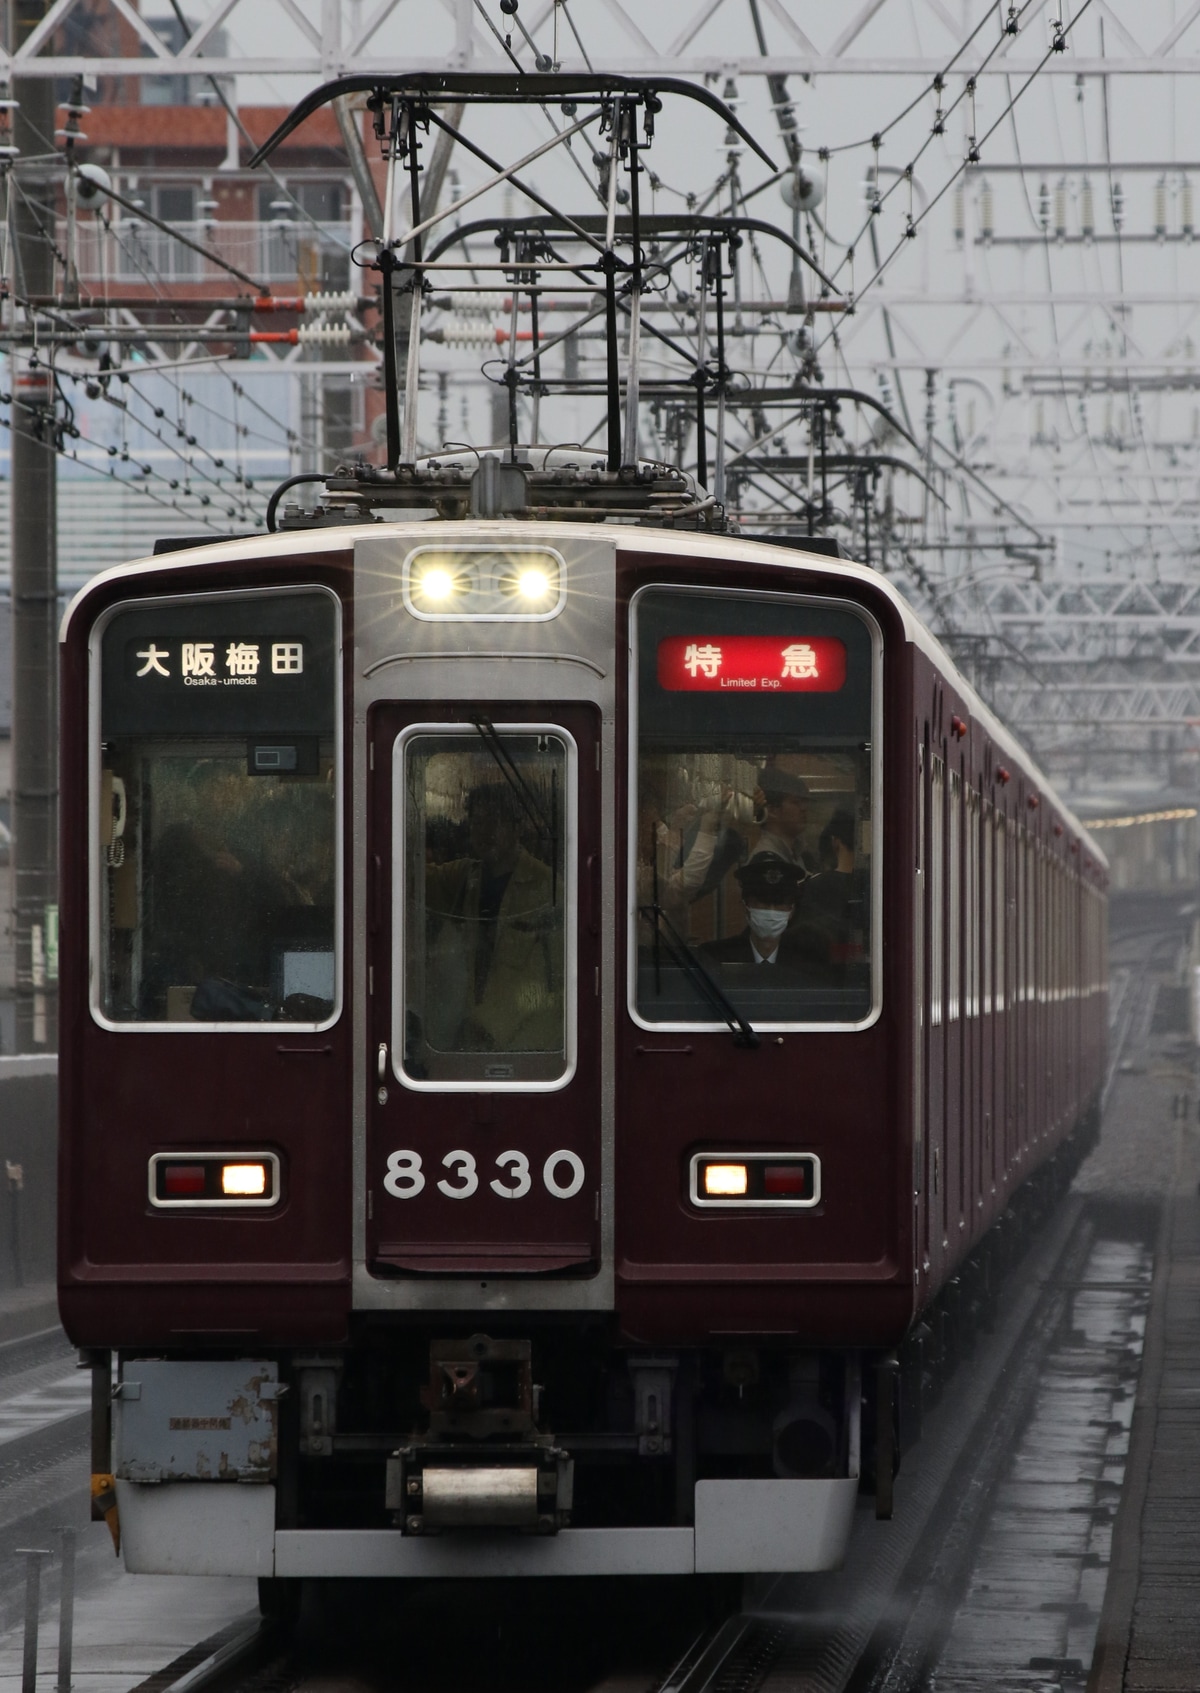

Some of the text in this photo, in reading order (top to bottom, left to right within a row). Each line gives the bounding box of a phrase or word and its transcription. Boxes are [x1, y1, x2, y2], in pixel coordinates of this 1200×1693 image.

[136, 643, 303, 677] 大阪梅田
[684, 644, 819, 678] 特急
[184, 676, 257, 686] Osaka-umeda
[720, 678, 782, 688] Limited Exp.
[383, 1150, 585, 1199] 8330
